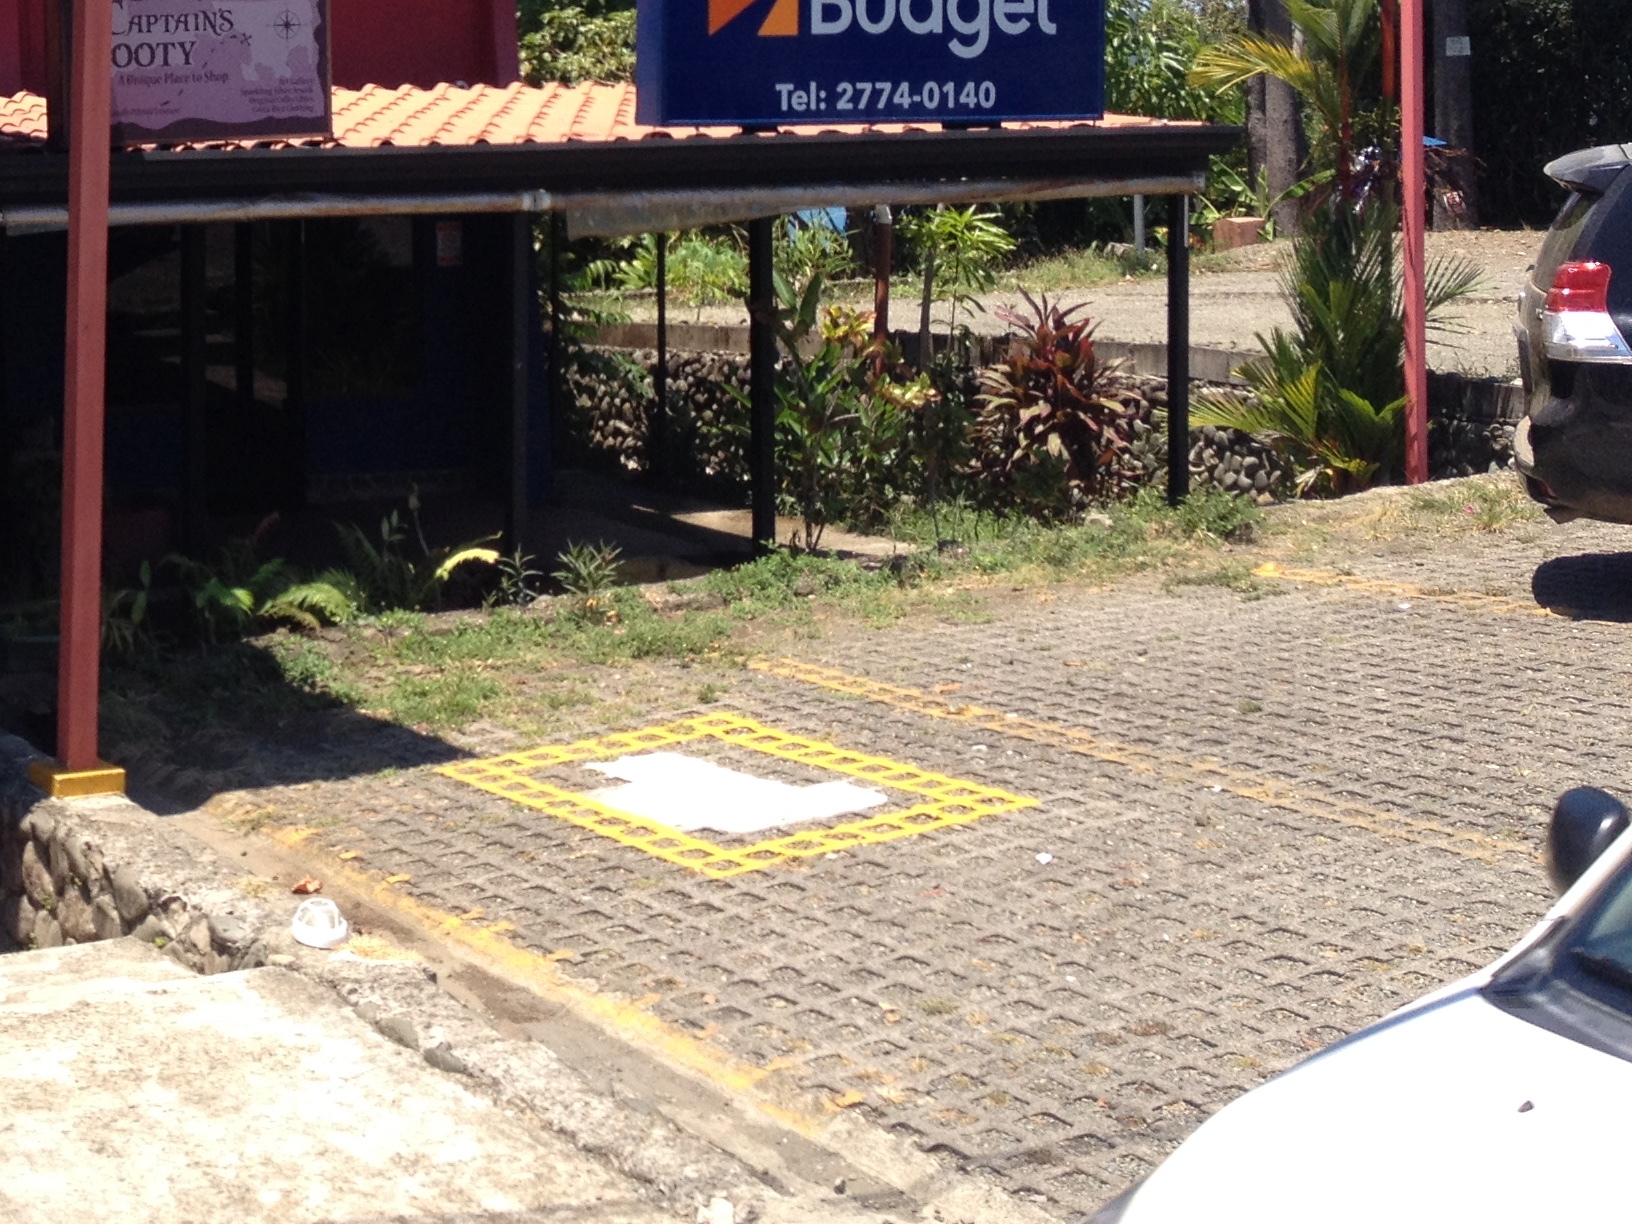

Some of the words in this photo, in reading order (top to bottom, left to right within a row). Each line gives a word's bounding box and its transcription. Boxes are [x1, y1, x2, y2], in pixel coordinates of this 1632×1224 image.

[111, 41, 197, 68] OOTY
[192, 74, 203, 83] to
[204, 71, 229, 84] Shop
[775, 83, 826, 111] Tel:
[836, 81, 996, 110] 2774-0140
